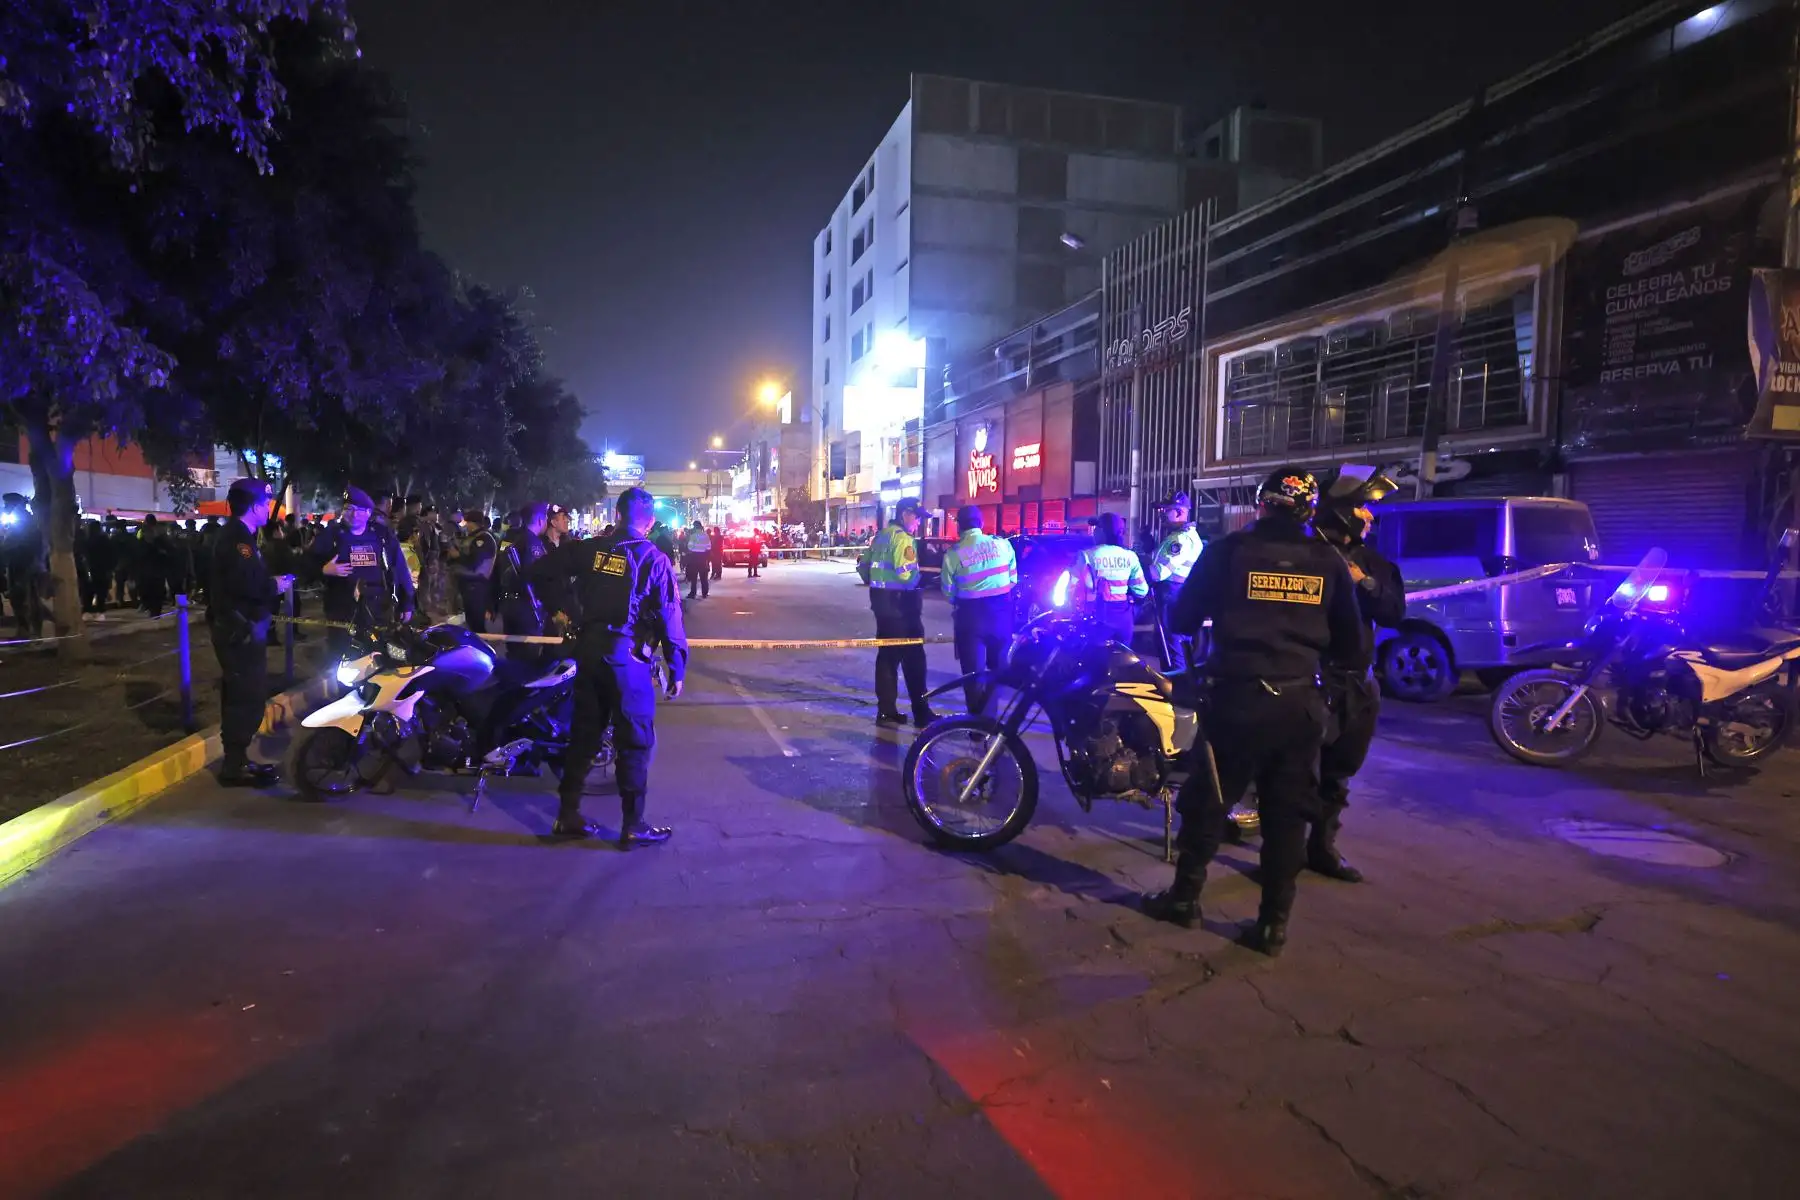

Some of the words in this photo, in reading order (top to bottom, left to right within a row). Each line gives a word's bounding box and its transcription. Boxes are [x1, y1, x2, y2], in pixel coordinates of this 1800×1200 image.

[1606, 271, 1685, 299] CELEBRA
[1691, 262, 1715, 280] TU
[1600, 359, 1681, 383] RESERVA
[967, 466, 998, 499] Wong
[1251, 575, 1304, 591] SERENAZGO
